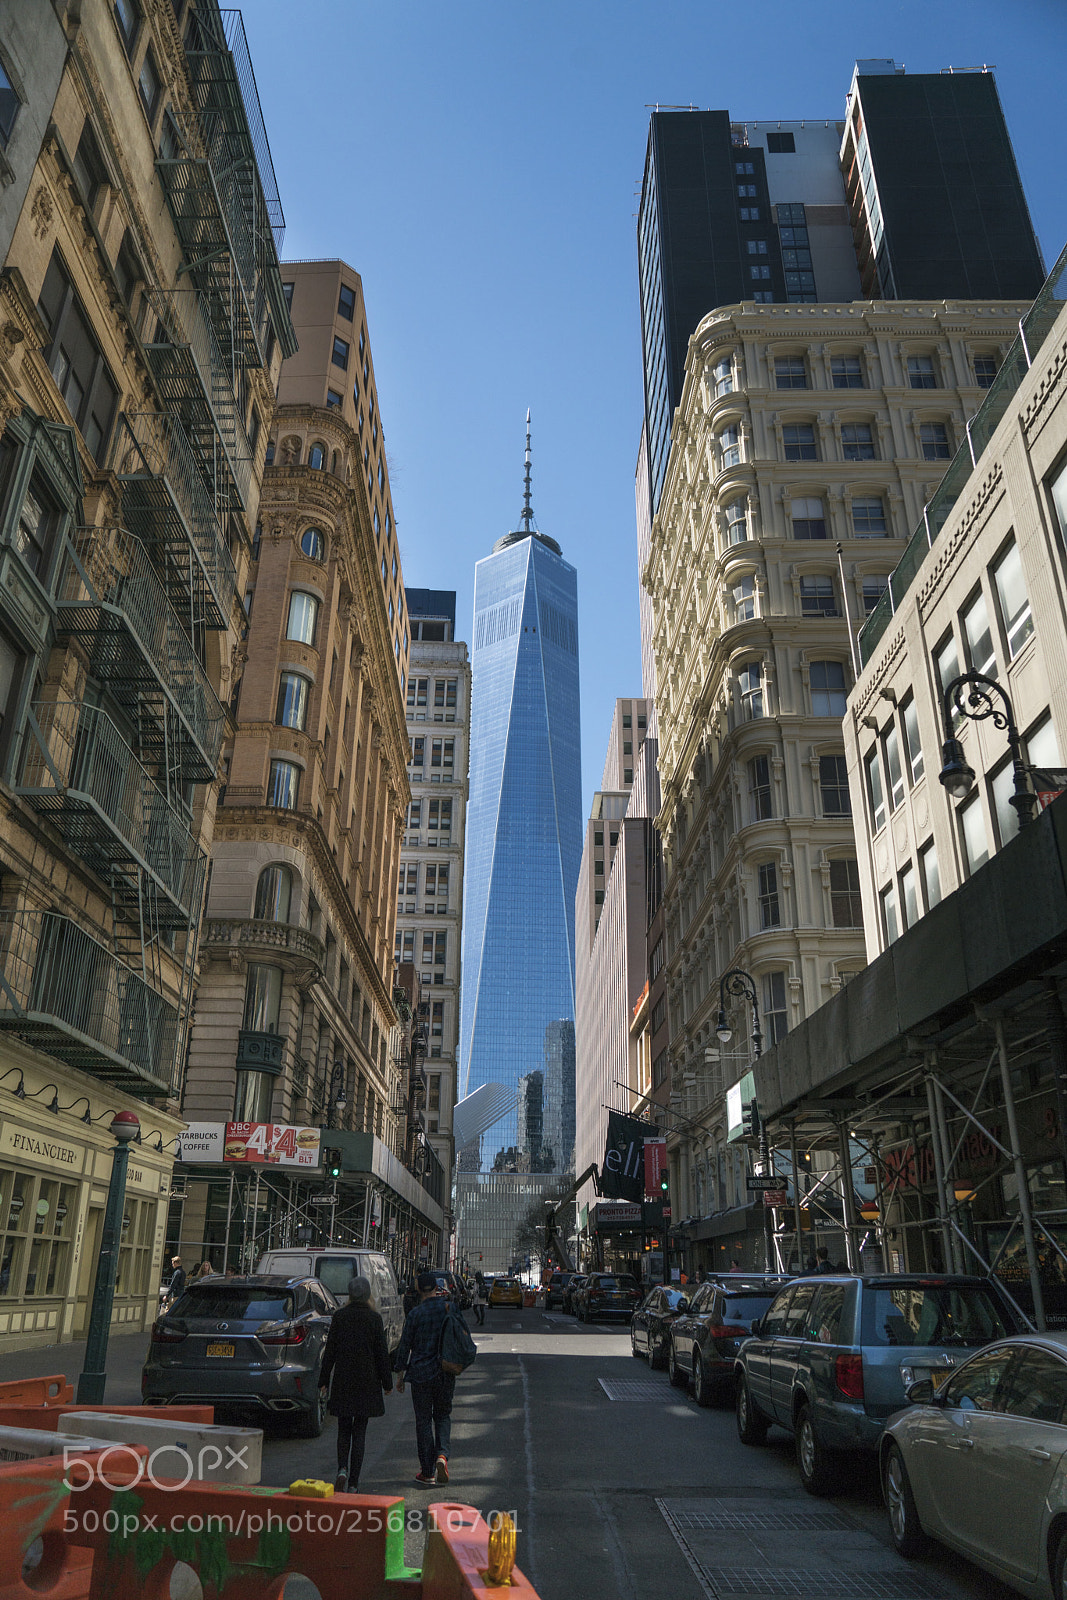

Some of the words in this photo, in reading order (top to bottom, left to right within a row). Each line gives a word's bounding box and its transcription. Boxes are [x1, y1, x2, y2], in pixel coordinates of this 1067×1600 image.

[230, 1122, 251, 1131] JBC
[178, 1132, 218, 1140] STARBUCKS
[245, 1125, 268, 1155] 4
[13, 1133, 75, 1163] FINANCIER
[183, 1143, 210, 1151] COFFEE
[298, 1156, 313, 1164] BLT
[599, 1208, 623, 1216] PRONTO
